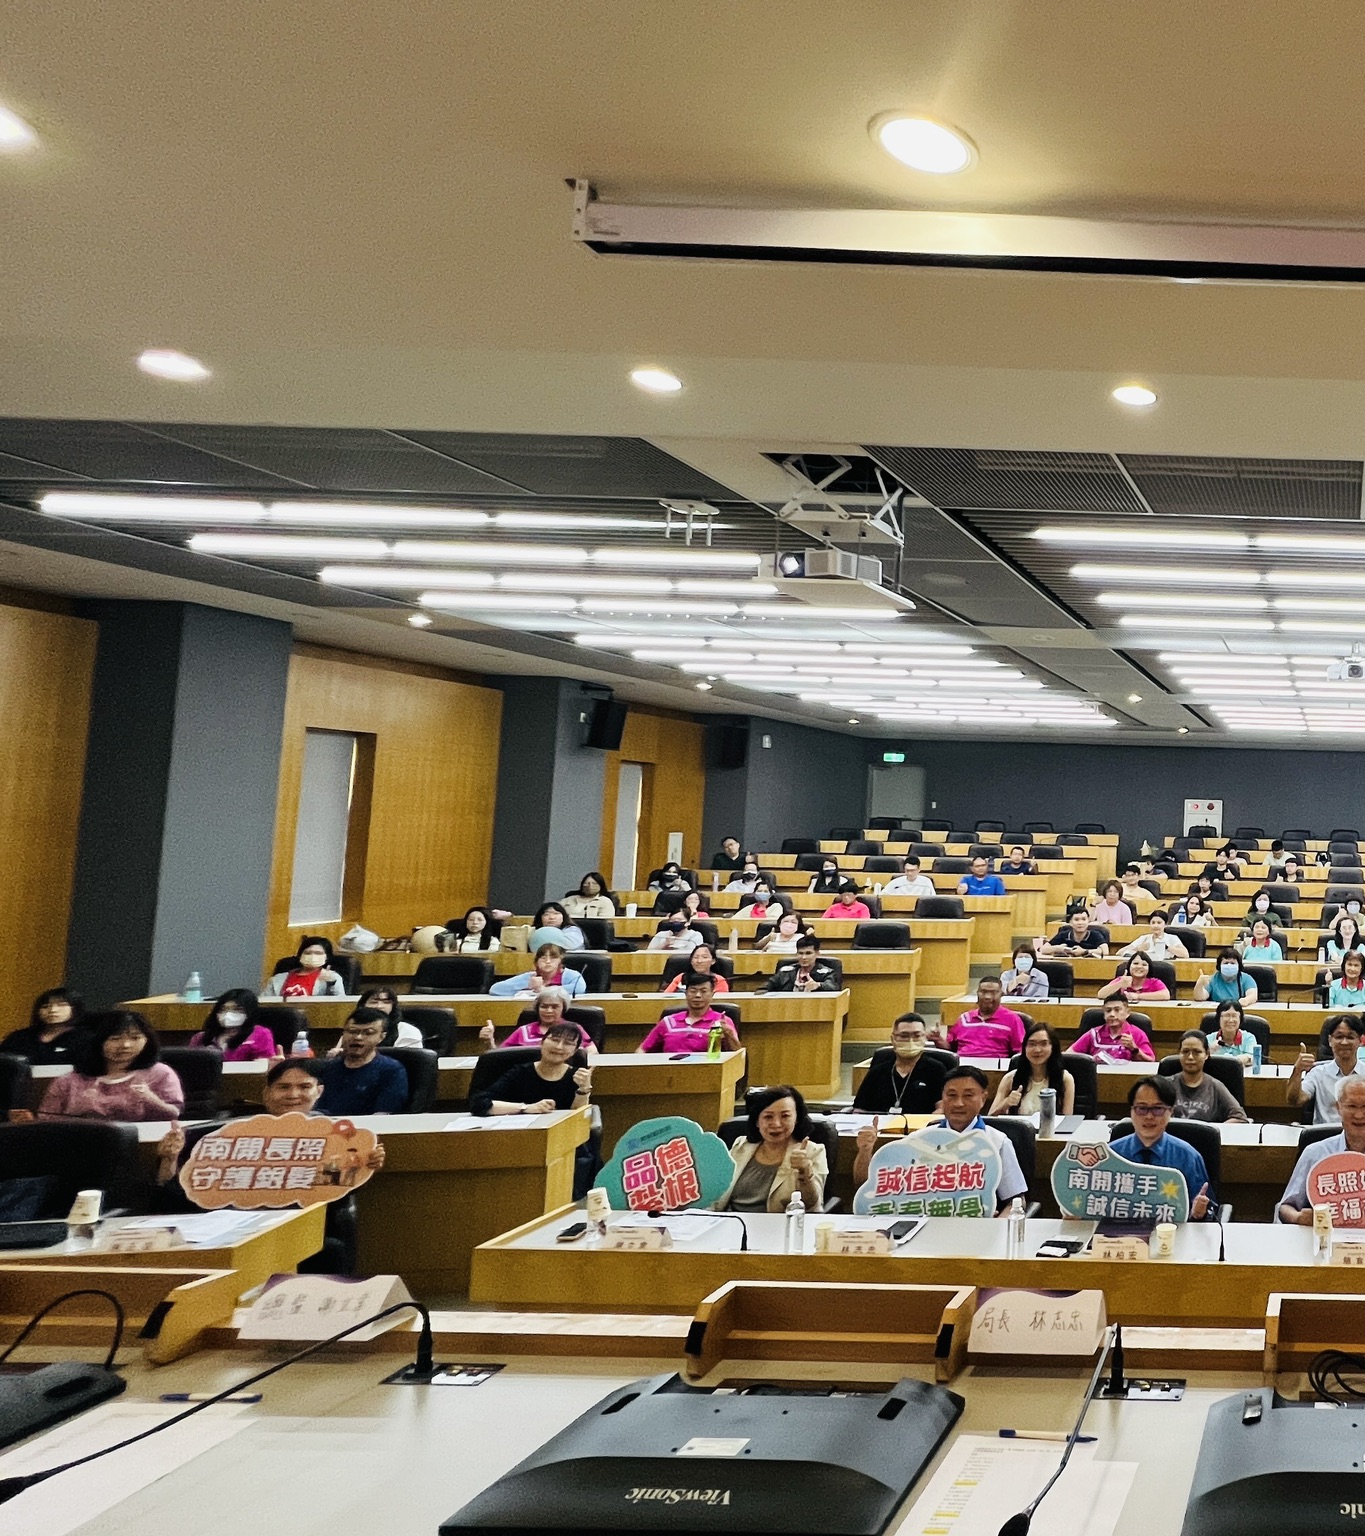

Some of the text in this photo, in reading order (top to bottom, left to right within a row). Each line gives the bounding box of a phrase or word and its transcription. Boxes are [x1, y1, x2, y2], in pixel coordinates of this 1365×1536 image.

[197, 1137, 326, 1161] 南開長照
[623, 1137, 693, 1192] 品德
[876, 1162, 985, 1196] 誠信起航
[1068, 1169, 1157, 1195] 南開攜手
[1086, 1193, 1176, 1222] 誠信未來
[624, 1487, 731, 1505] ViewSonic
